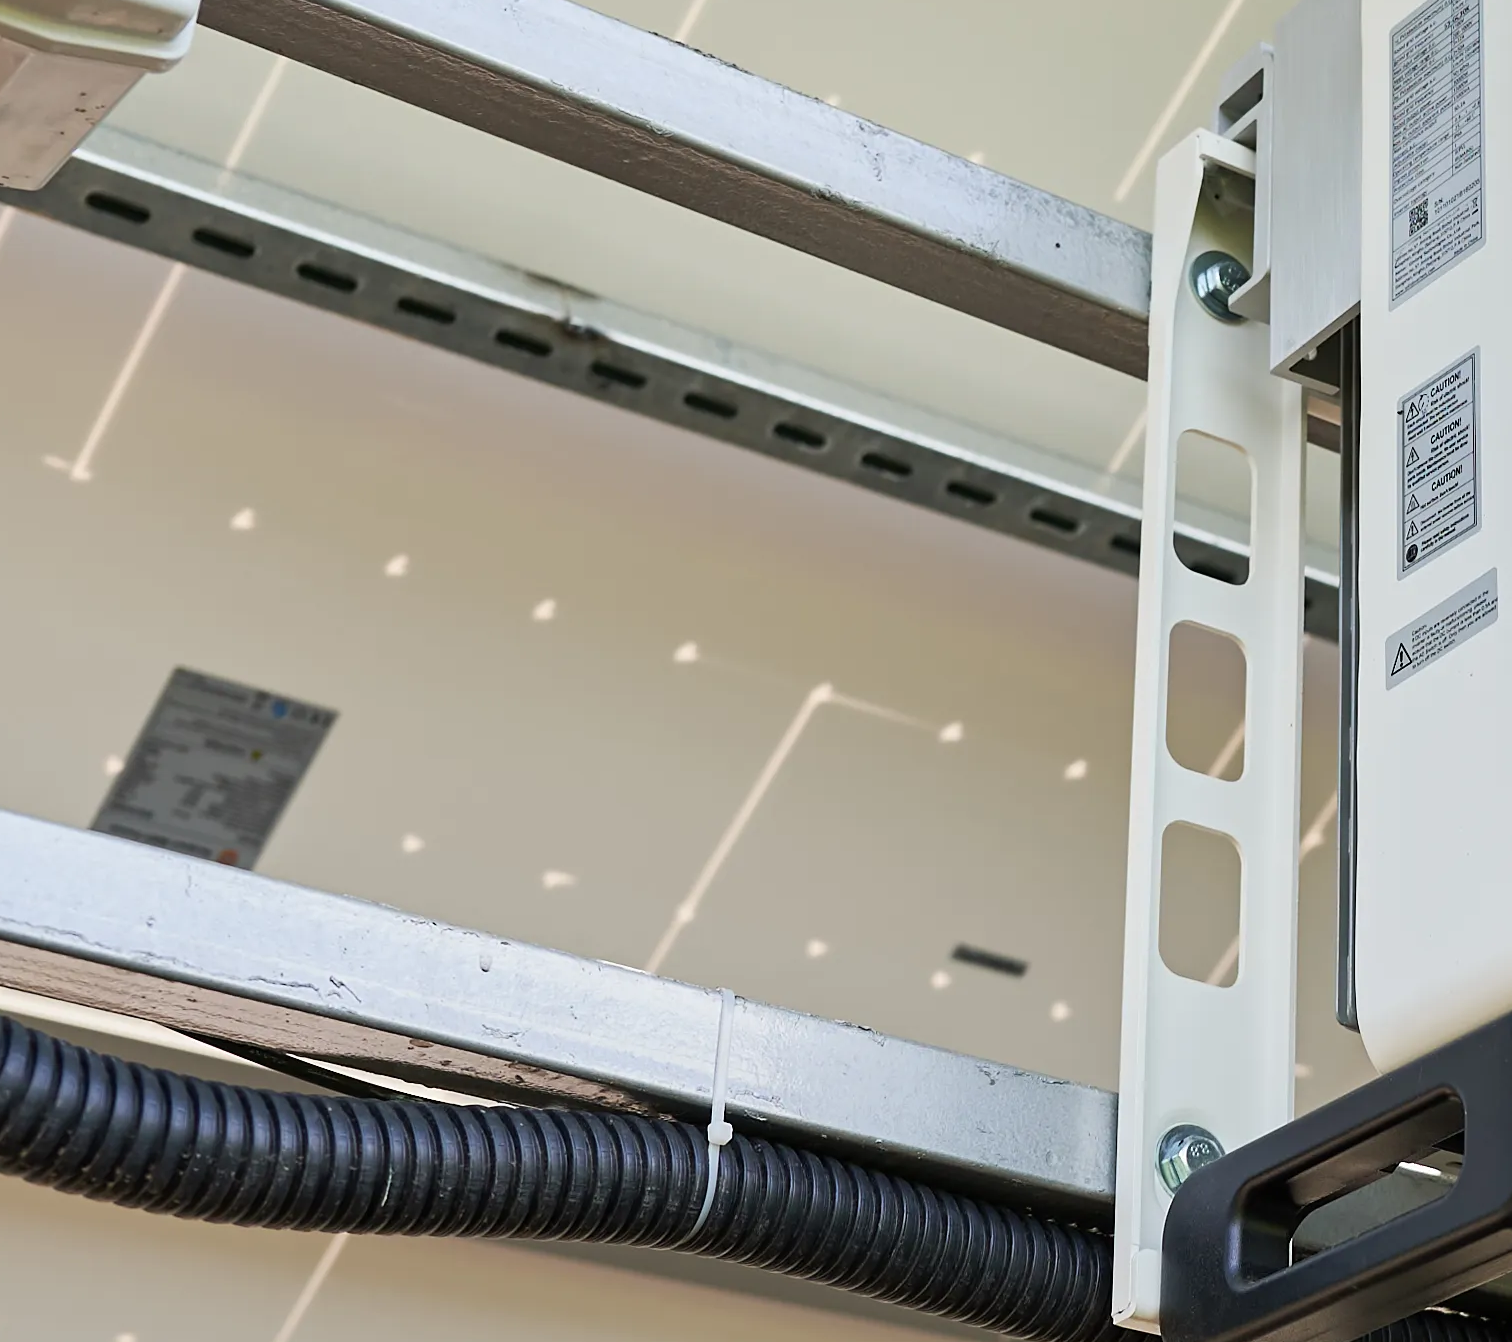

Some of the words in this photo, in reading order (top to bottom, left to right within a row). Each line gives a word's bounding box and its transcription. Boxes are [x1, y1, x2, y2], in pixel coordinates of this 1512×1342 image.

[1430, 370, 1461, 397] CAUTION!
[1431, 417, 1461, 444] CAUTION!
[1432, 464, 1462, 491] CAUTION!
